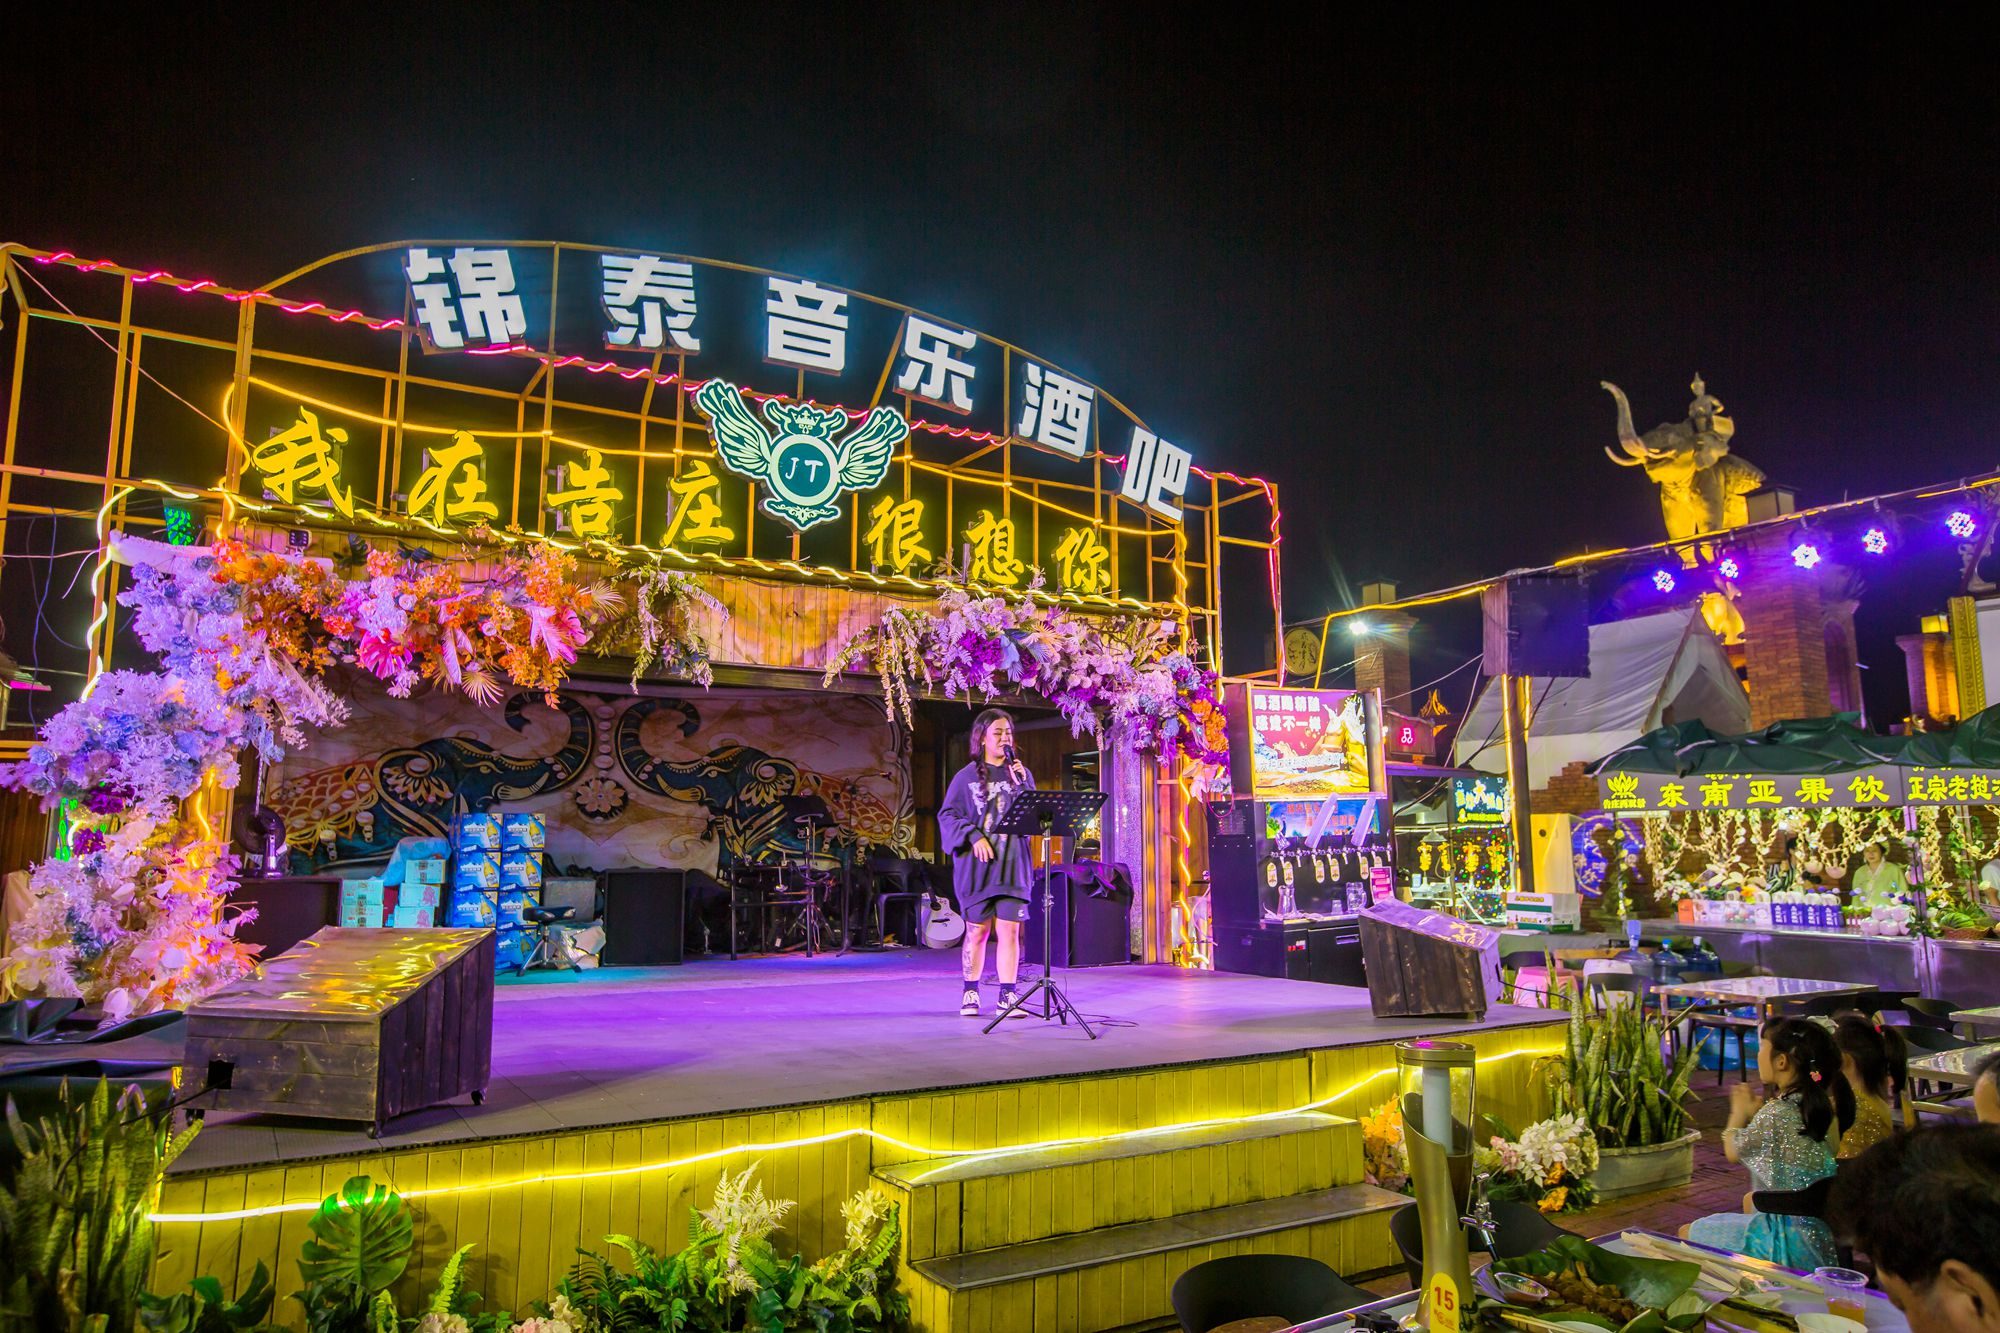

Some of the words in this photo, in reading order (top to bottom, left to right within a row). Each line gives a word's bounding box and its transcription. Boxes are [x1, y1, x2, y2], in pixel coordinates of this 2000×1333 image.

[405, 247, 1193, 522] 锦泰音乐酒吧
[784, 455, 824, 484] JT
[1657, 774, 1890, 808] 东南亚果饮
[1434, 1286, 1455, 1311] 15
